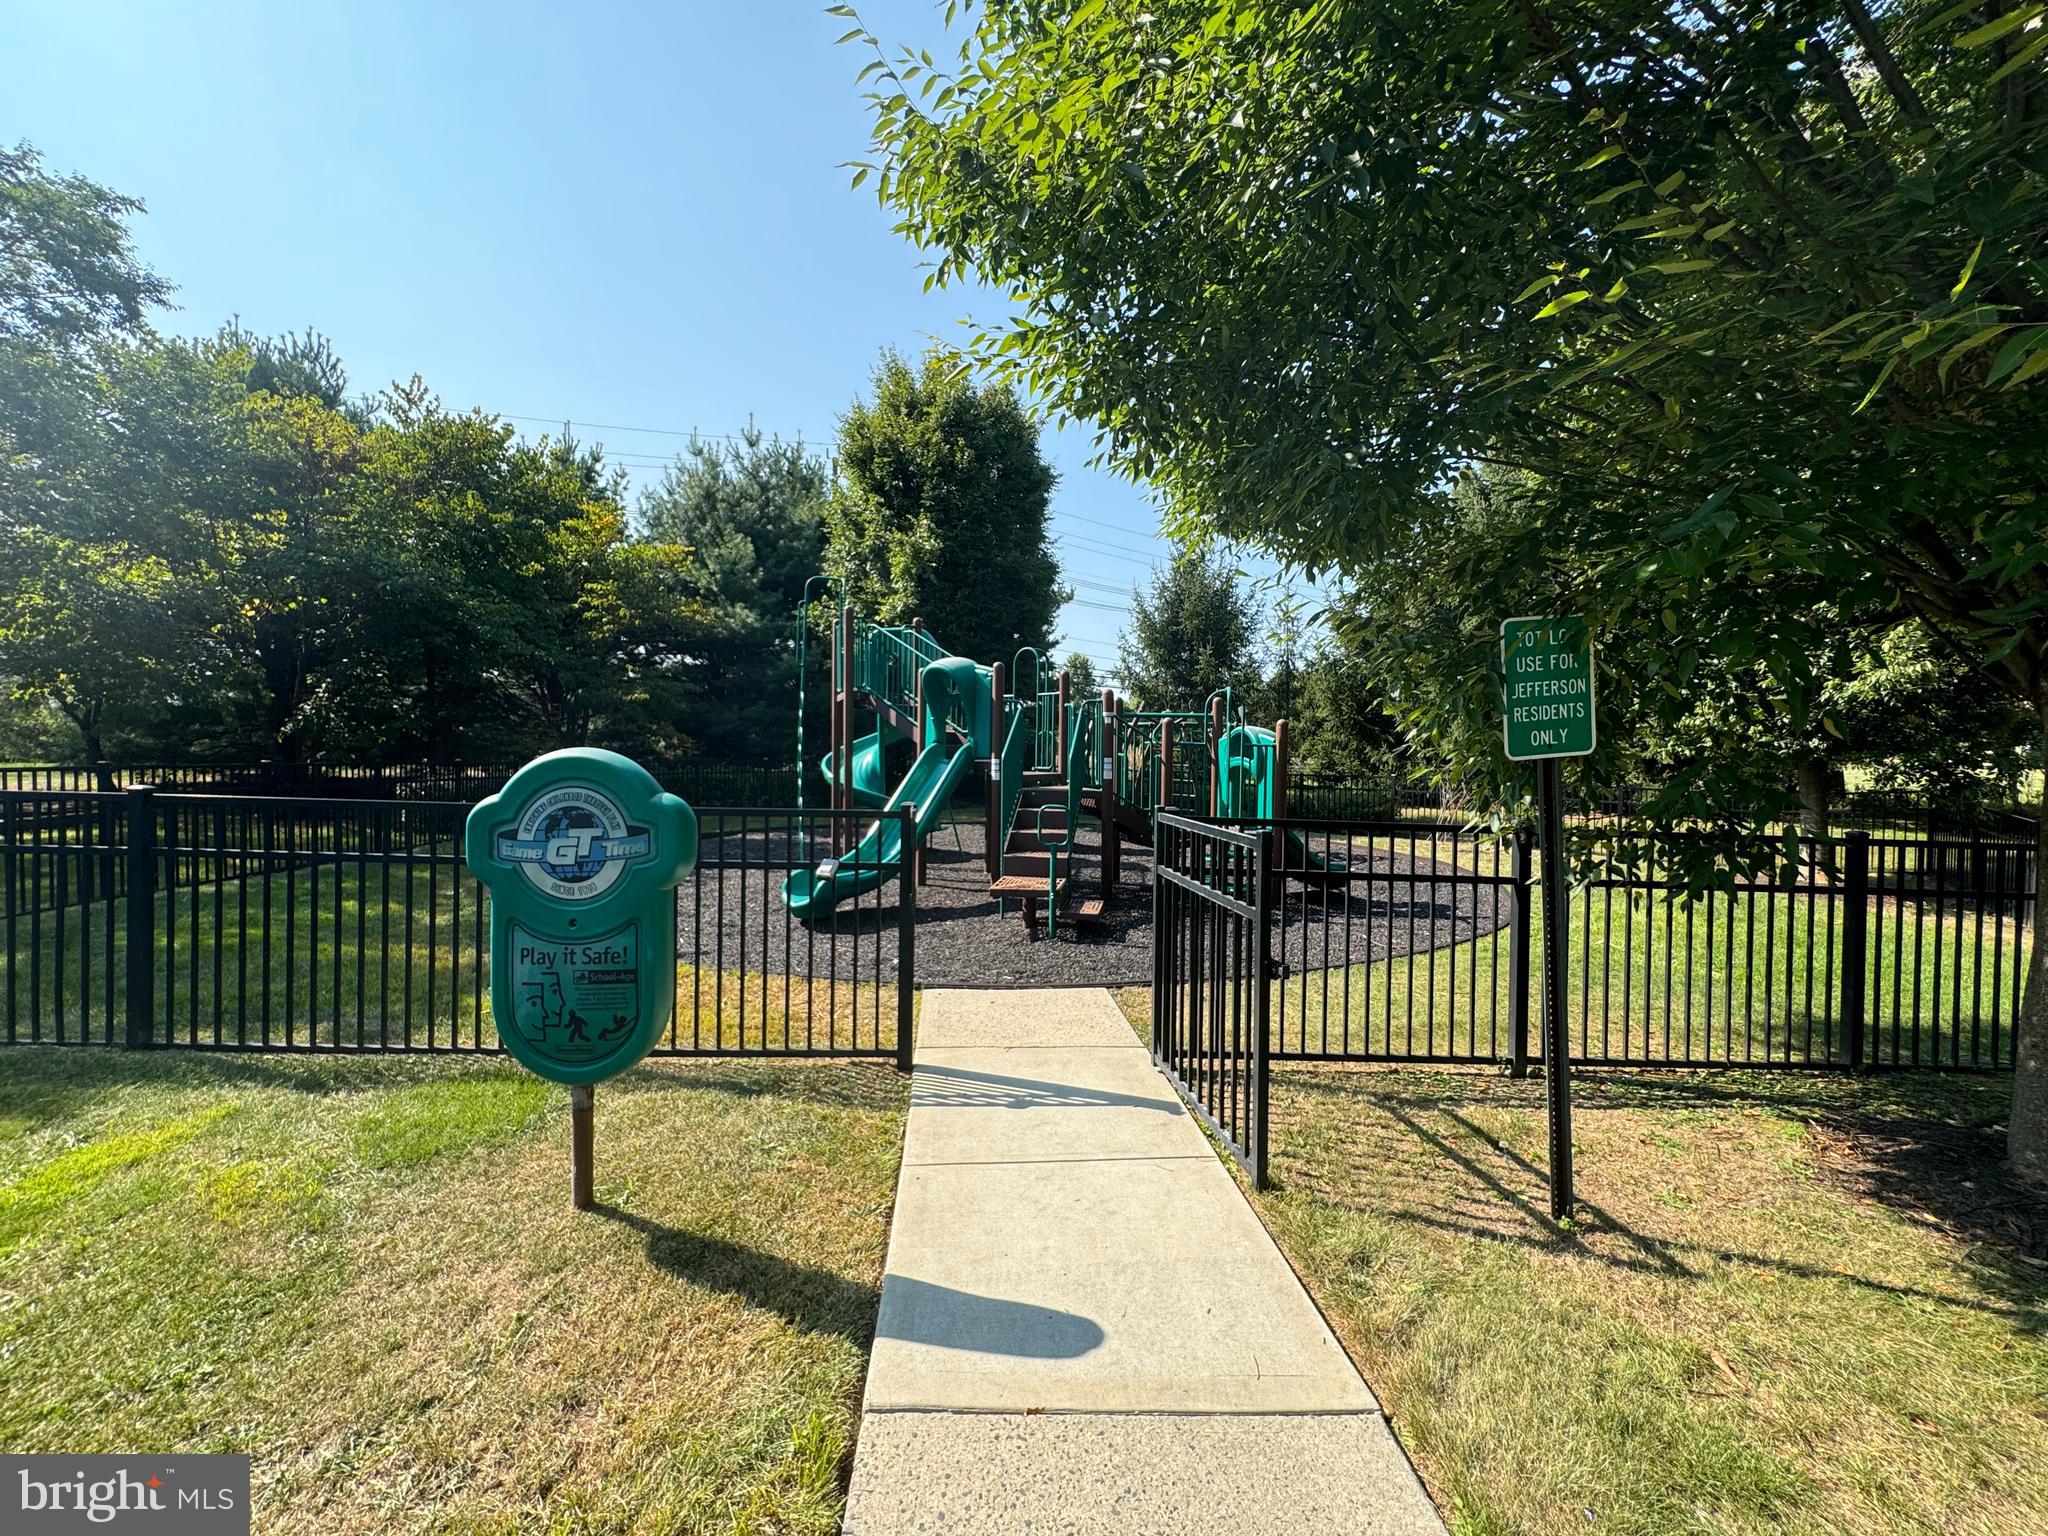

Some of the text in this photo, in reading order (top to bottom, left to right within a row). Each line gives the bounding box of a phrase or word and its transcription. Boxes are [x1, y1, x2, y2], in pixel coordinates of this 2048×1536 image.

[1516, 655, 1544, 673] USE
[1511, 678, 1586, 699] JEFFERSON
[1514, 702, 1585, 723] RESIDENTS
[1530, 728, 1569, 746] ONLY
[501, 827, 646, 865] Game GT Time
[520, 945, 628, 969] Play it Safe!
[590, 971, 636, 983] School-Age
